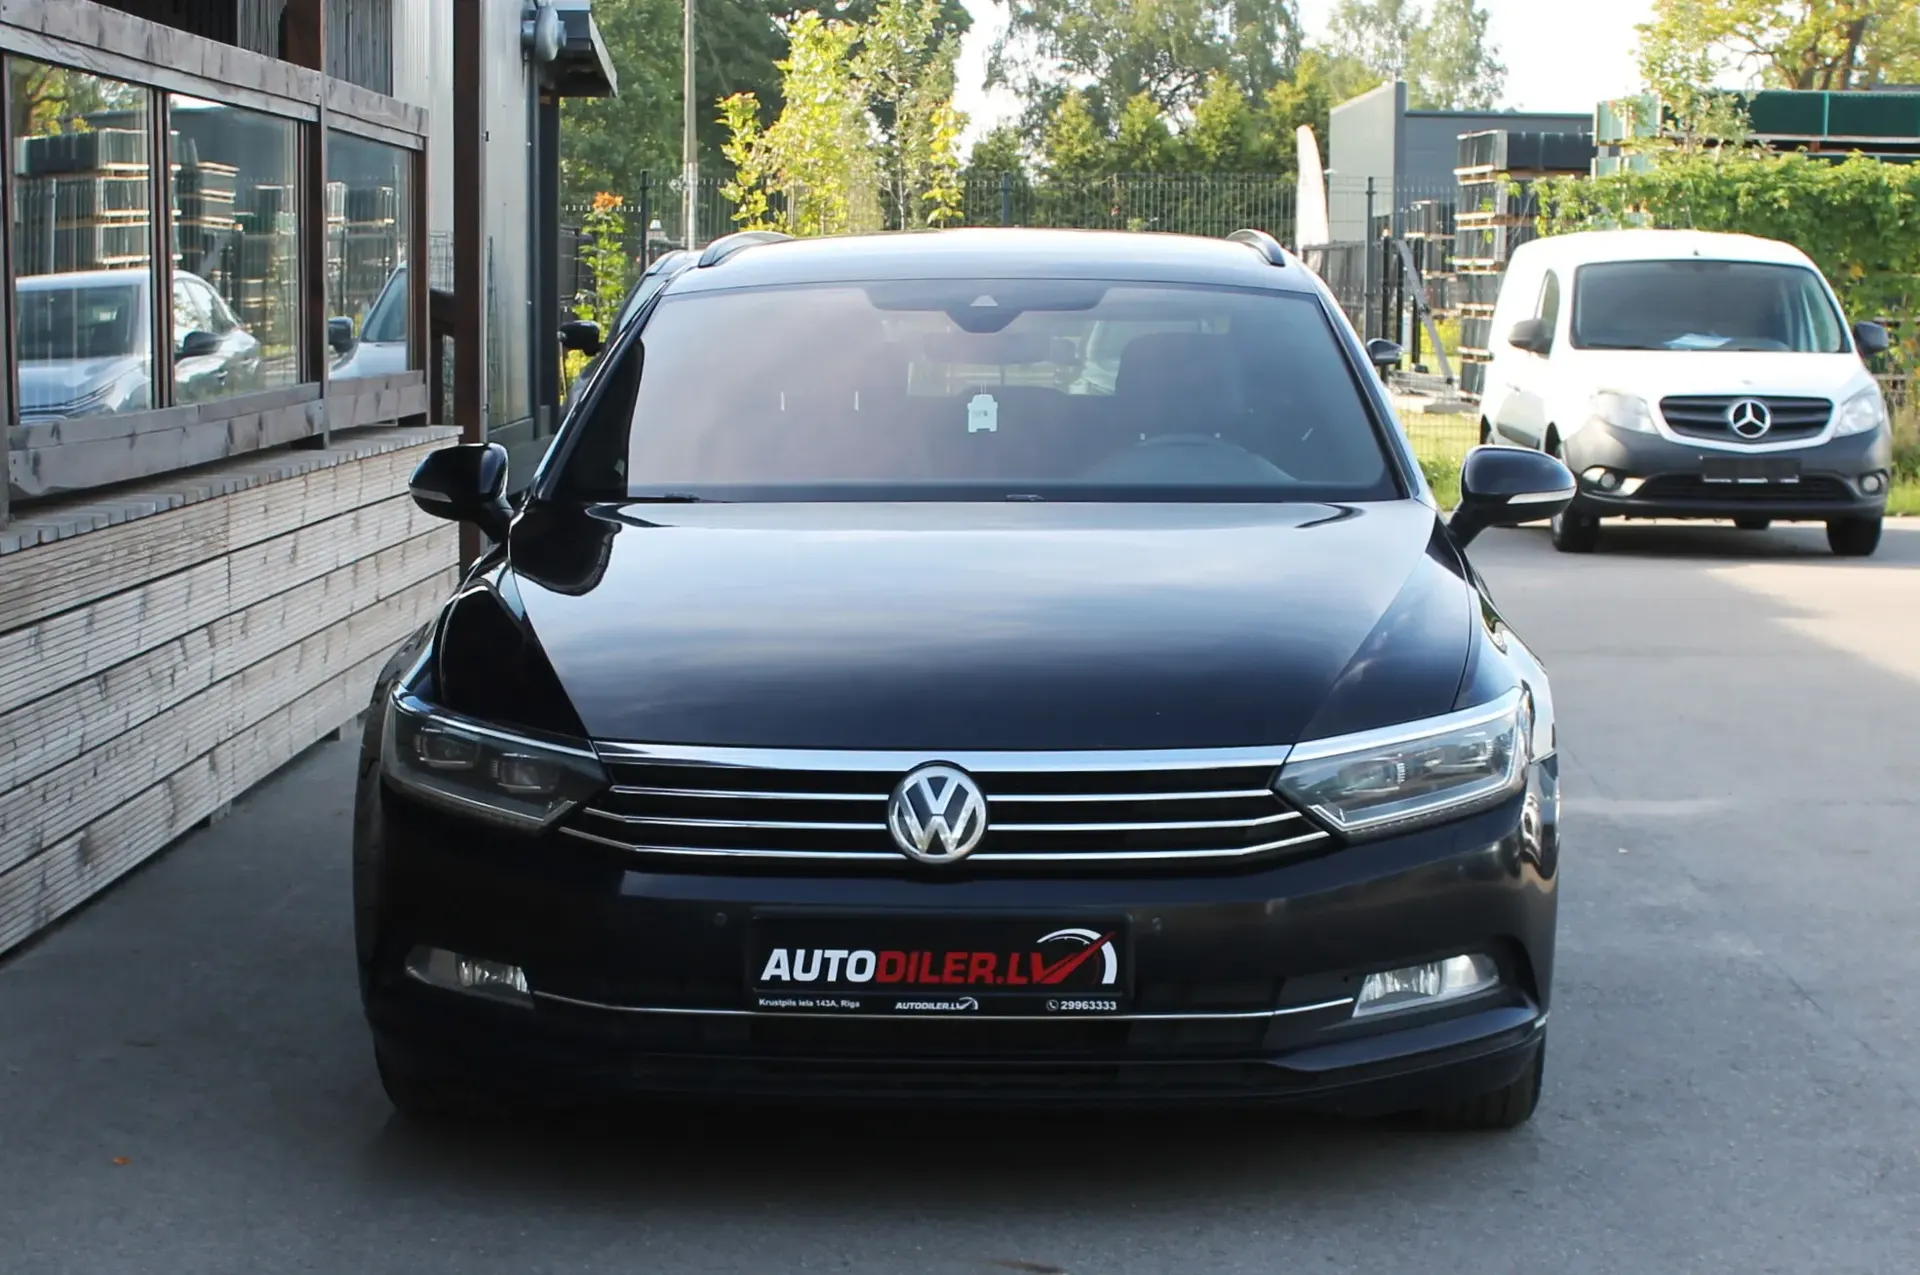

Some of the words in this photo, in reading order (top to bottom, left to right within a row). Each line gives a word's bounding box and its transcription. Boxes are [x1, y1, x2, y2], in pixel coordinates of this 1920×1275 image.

[890, 766, 986, 864] VW
[760, 931, 1115, 985] AUTODILER.LV
[759, 998, 796, 1008] Krustpils
[895, 1000, 973, 1010] AUTODILER.LV
[1060, 1000, 1117, 1010] 29963333
